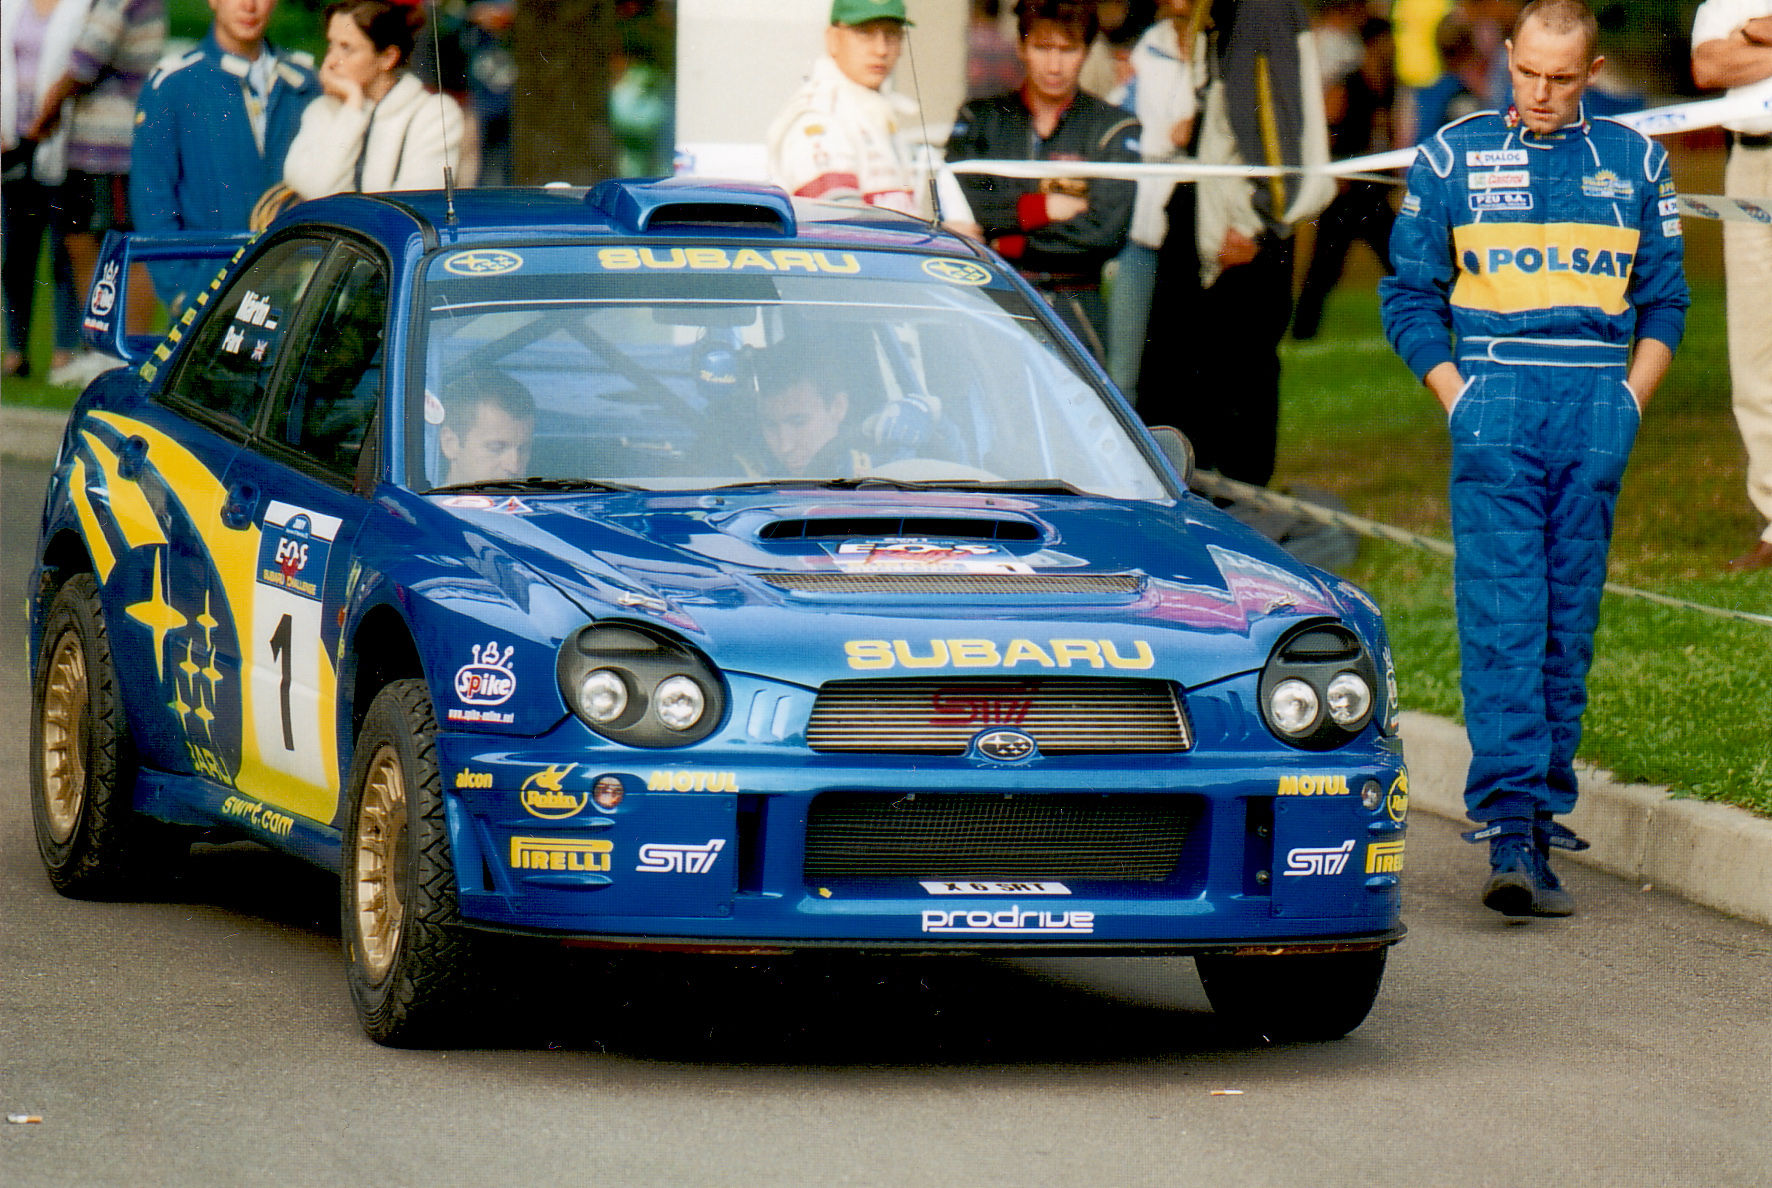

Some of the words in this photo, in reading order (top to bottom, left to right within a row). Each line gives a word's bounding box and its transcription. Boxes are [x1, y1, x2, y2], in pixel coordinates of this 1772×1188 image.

[1488, 174, 1524, 184] Castrol
[598, 248, 862, 275] SUBARU
[1489, 246, 1632, 278] POLSAT
[844, 639, 1155, 669] SUBARU
[269, 614, 295, 751] 1
[458, 671, 512, 699] Spike
[456, 768, 493, 789] alcon
[648, 771, 740, 793] MOTUL
[1277, 775, 1350, 796] MOTUL
[222, 796, 294, 837] swrt.com
[511, 837, 614, 872] PIRELLI
[922, 905, 1095, 932] prodrive
